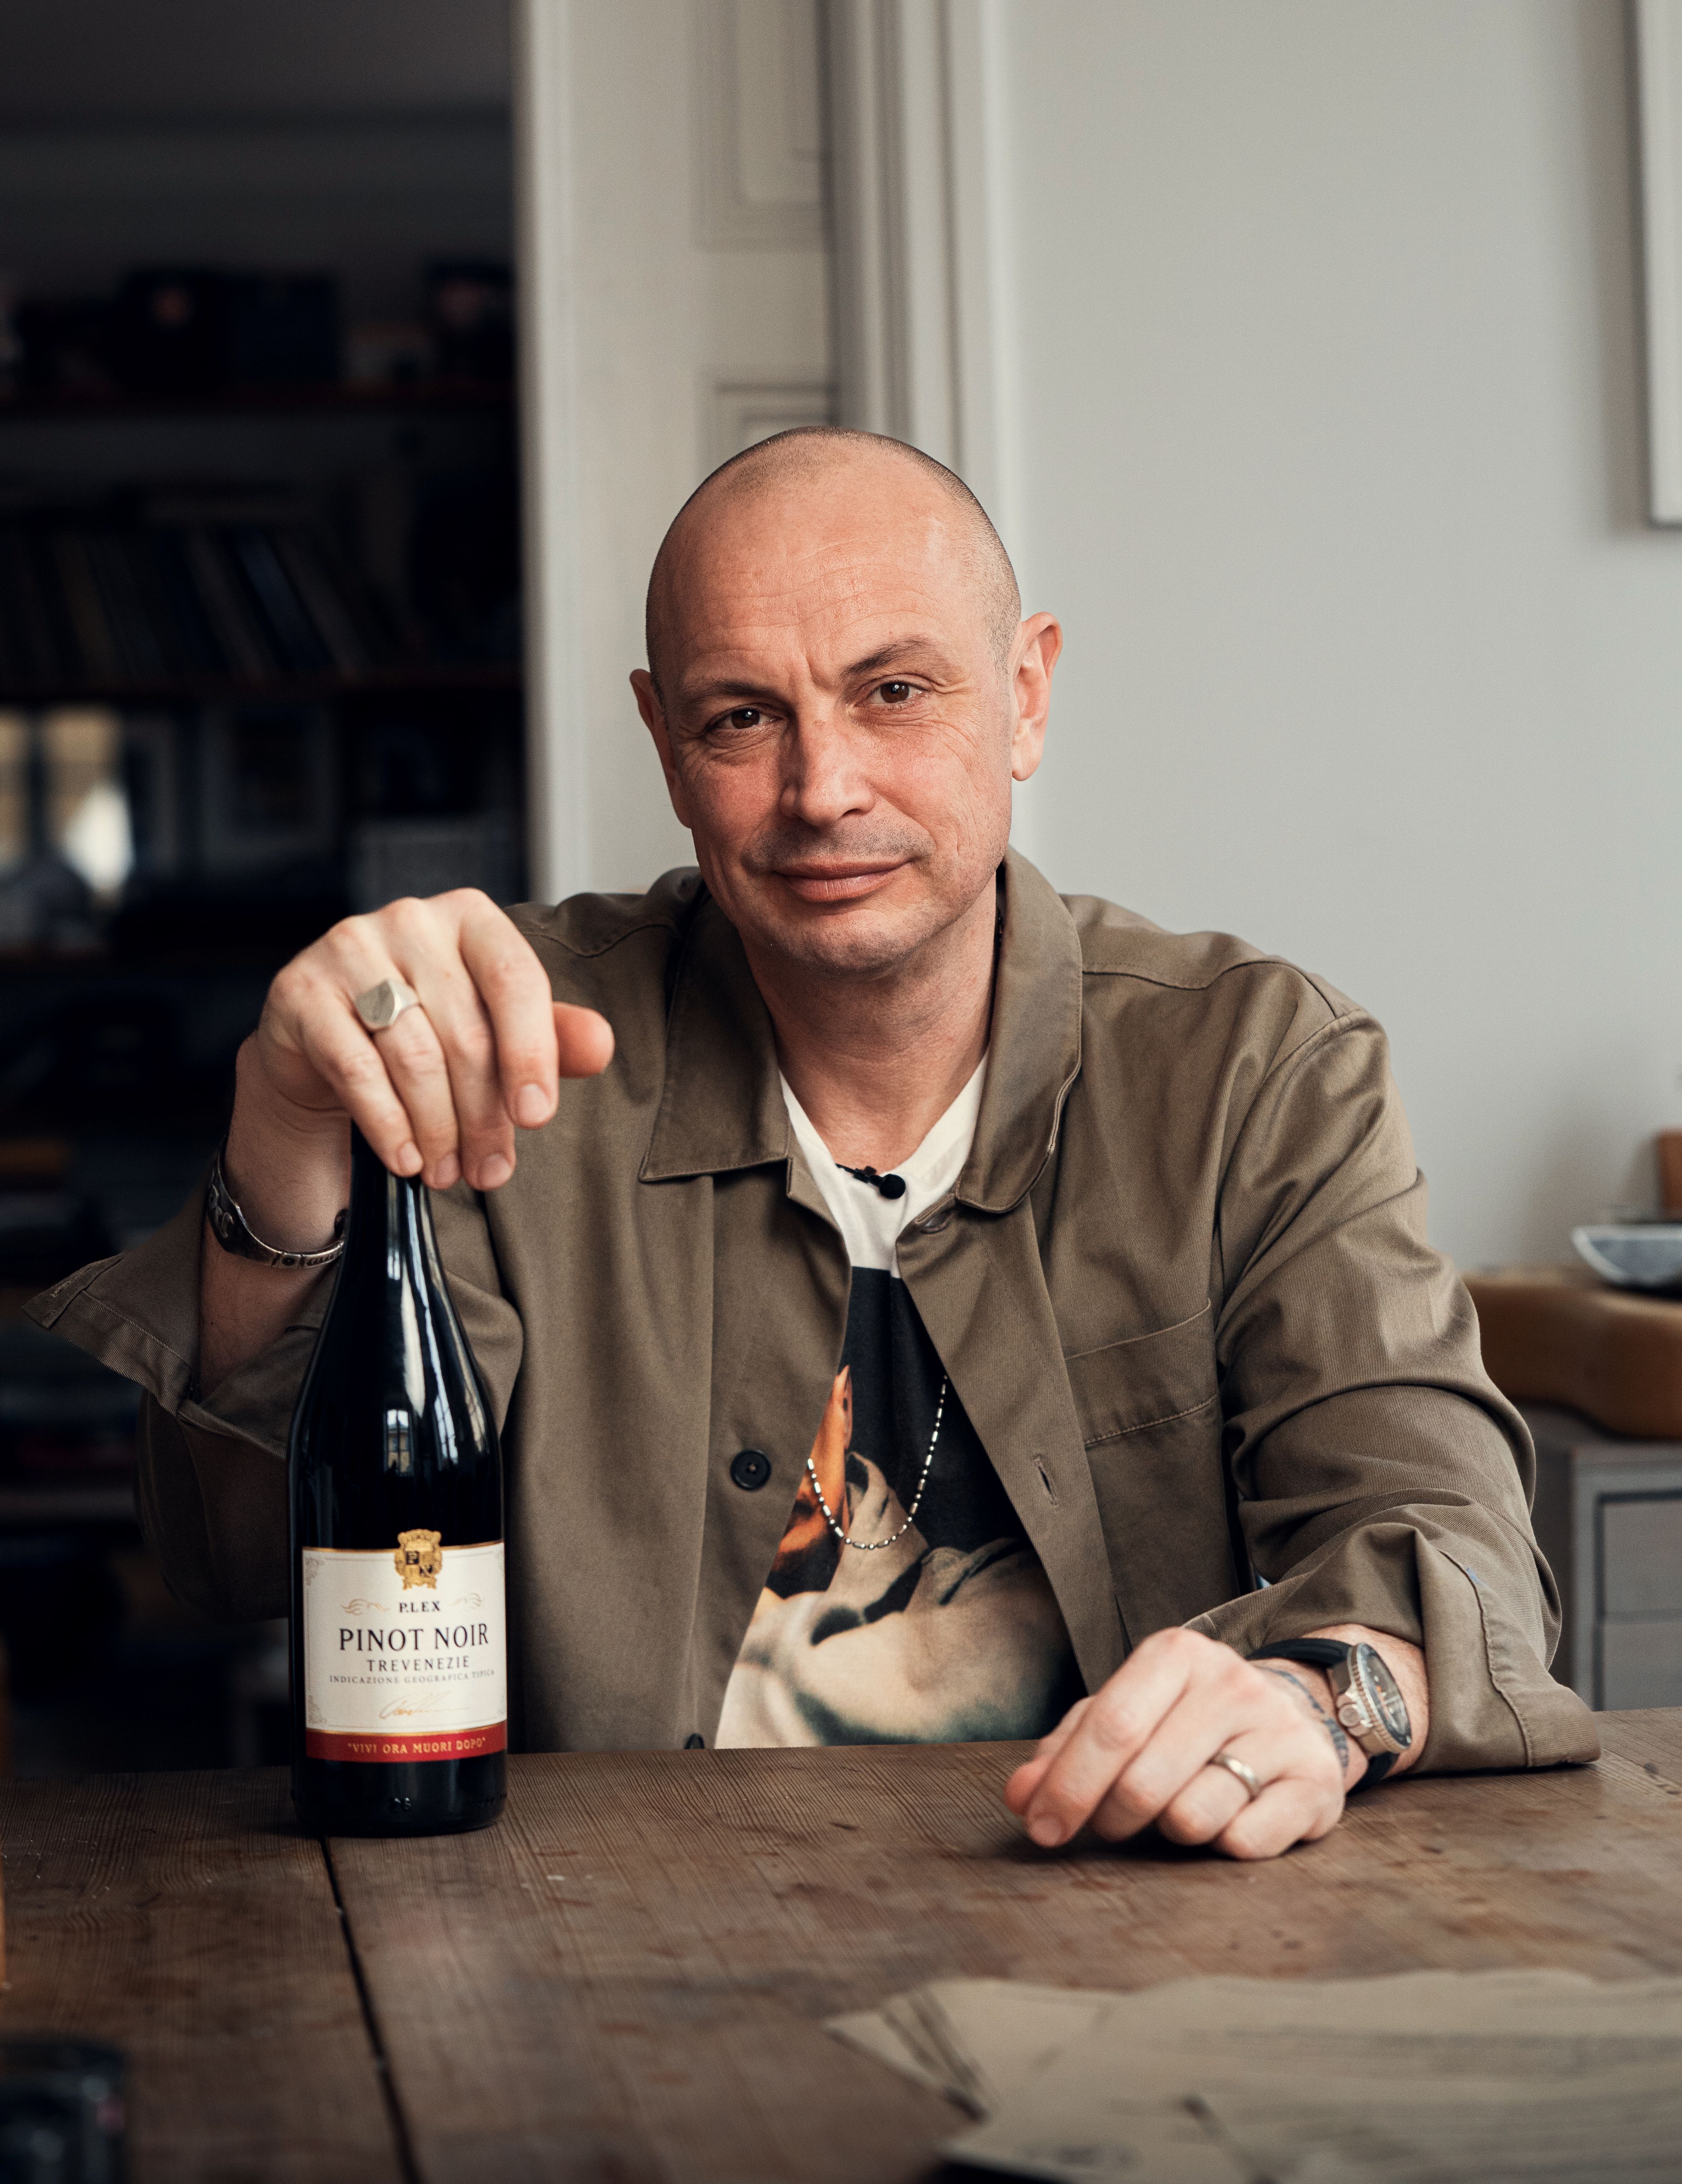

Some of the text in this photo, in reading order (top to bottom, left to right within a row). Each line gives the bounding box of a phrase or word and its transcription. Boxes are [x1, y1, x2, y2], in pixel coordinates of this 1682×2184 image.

[339, 1623, 488, 1651] PINOT NOIR
[367, 1655, 469, 1671] TREVENEZIE
[330, 1675, 400, 1684] INDICAZIONE
[404, 1673, 468, 1684] GEOGRAFICA
[382, 1744, 407, 1754] ORA
[413, 1741, 452, 1753] MUORI
